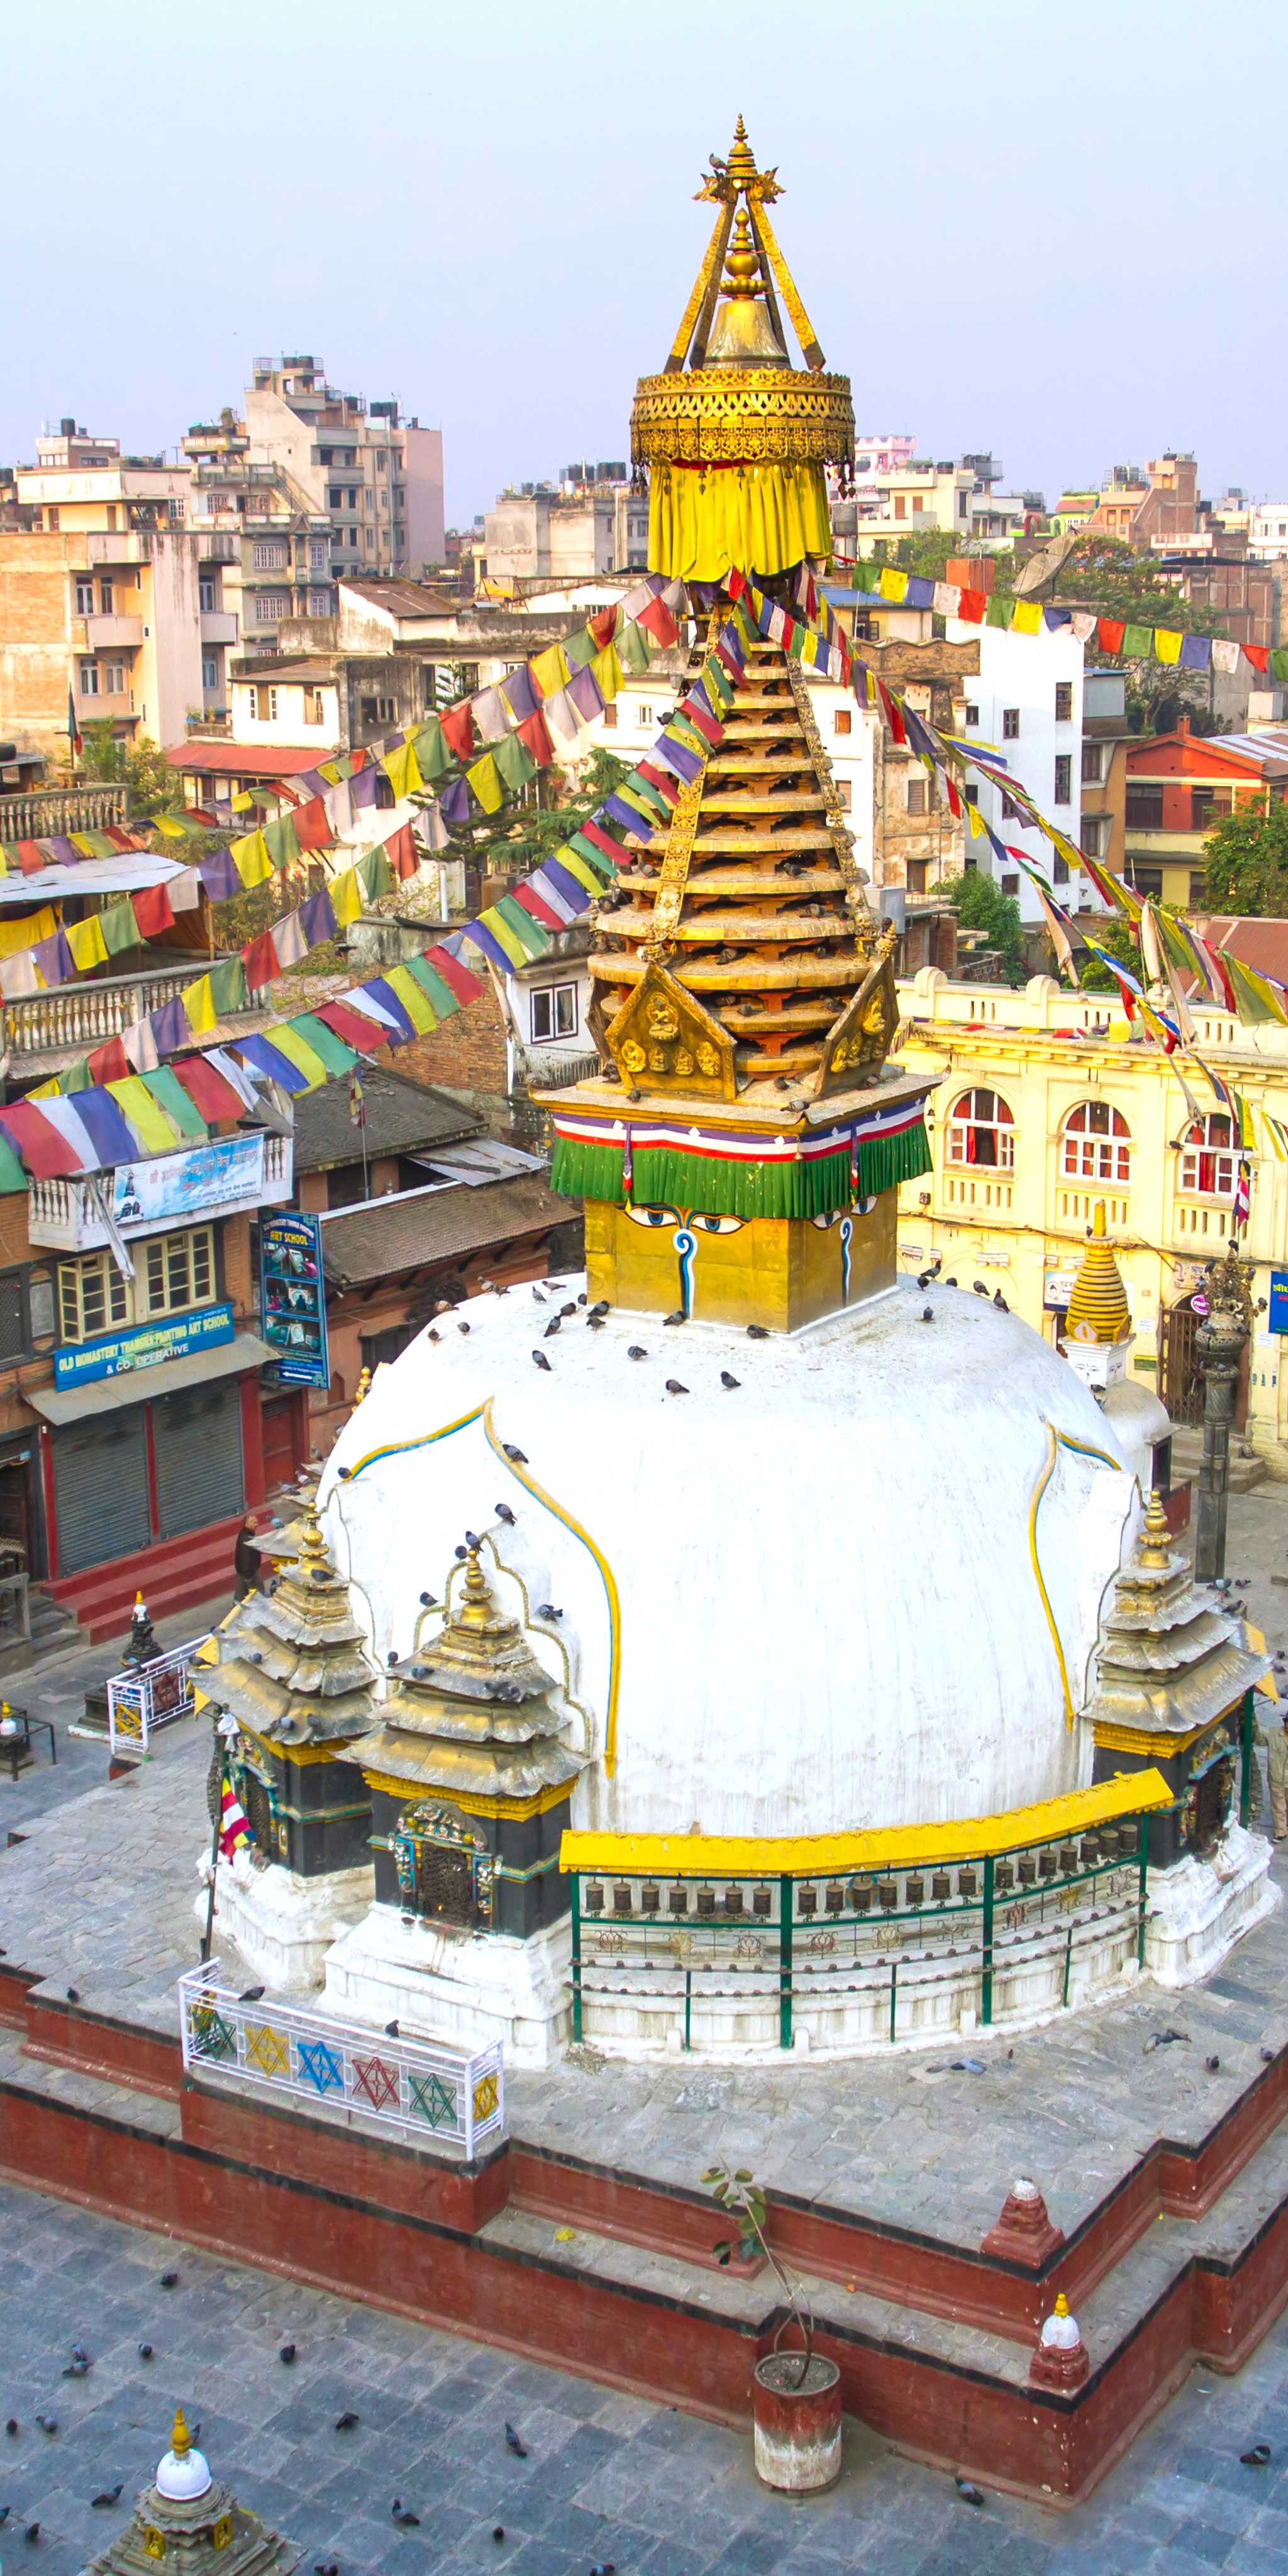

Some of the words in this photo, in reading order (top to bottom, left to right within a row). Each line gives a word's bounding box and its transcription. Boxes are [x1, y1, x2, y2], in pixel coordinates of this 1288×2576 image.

[270, 1230, 282, 1241] ART
[284, 1233, 308, 1246] SCHOOL
[59, 1356, 74, 1372] OLD
[75, 1344, 119, 1368] MONASTERY
[189, 1320, 202, 1335] ART
[203, 1313, 230, 1331] SCHOOL
[106, 1365, 114, 1374] &
[136, 1343, 189, 1366] OPERATIVE
